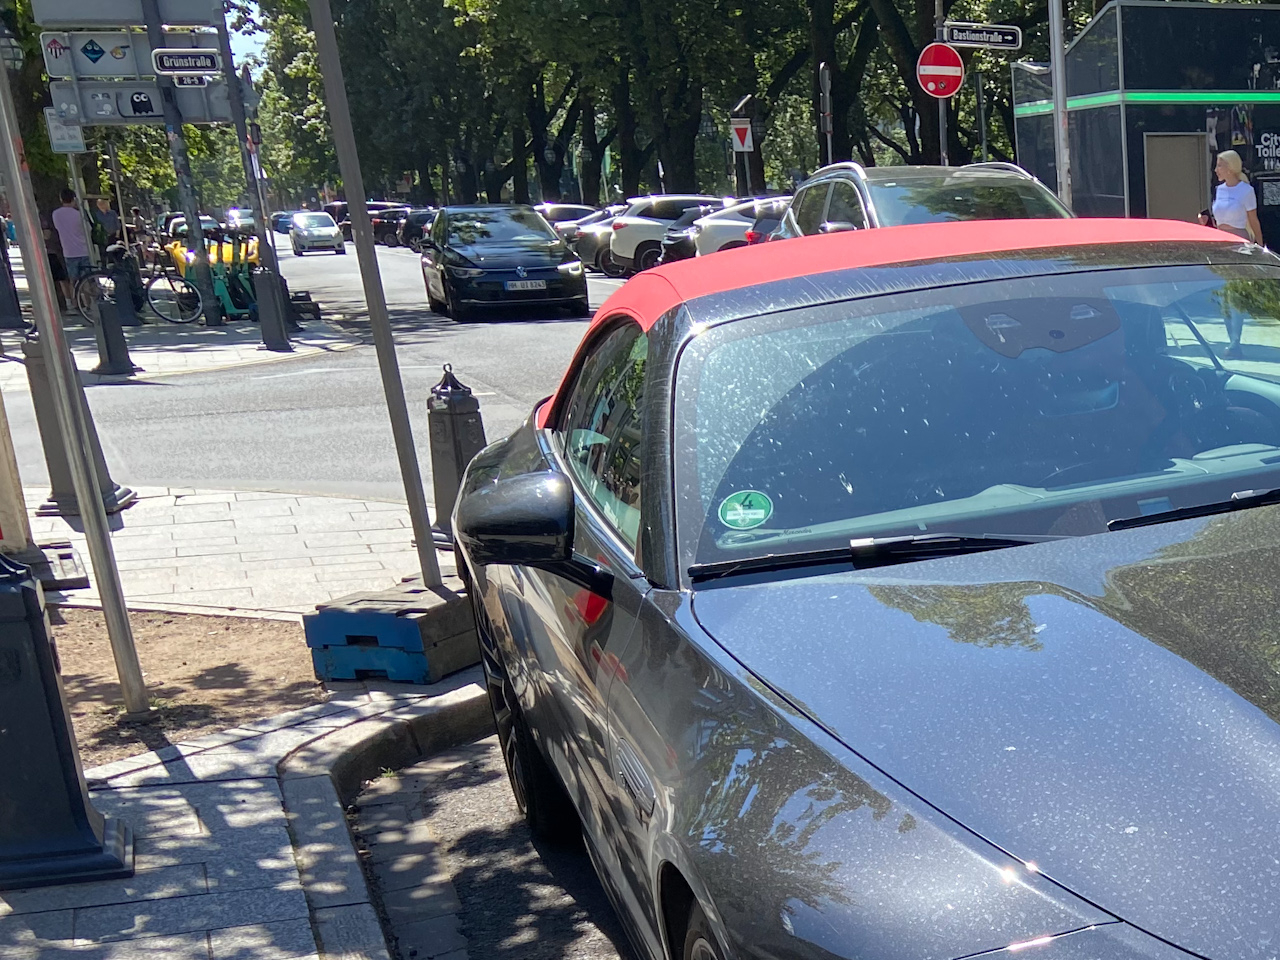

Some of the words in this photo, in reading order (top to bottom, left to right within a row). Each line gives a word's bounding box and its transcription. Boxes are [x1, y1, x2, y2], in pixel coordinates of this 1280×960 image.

[953, 29, 1003, 42] Bastionstraße
[163, 55, 211, 67] Grünstraße
[740, 493, 753, 509] 4
